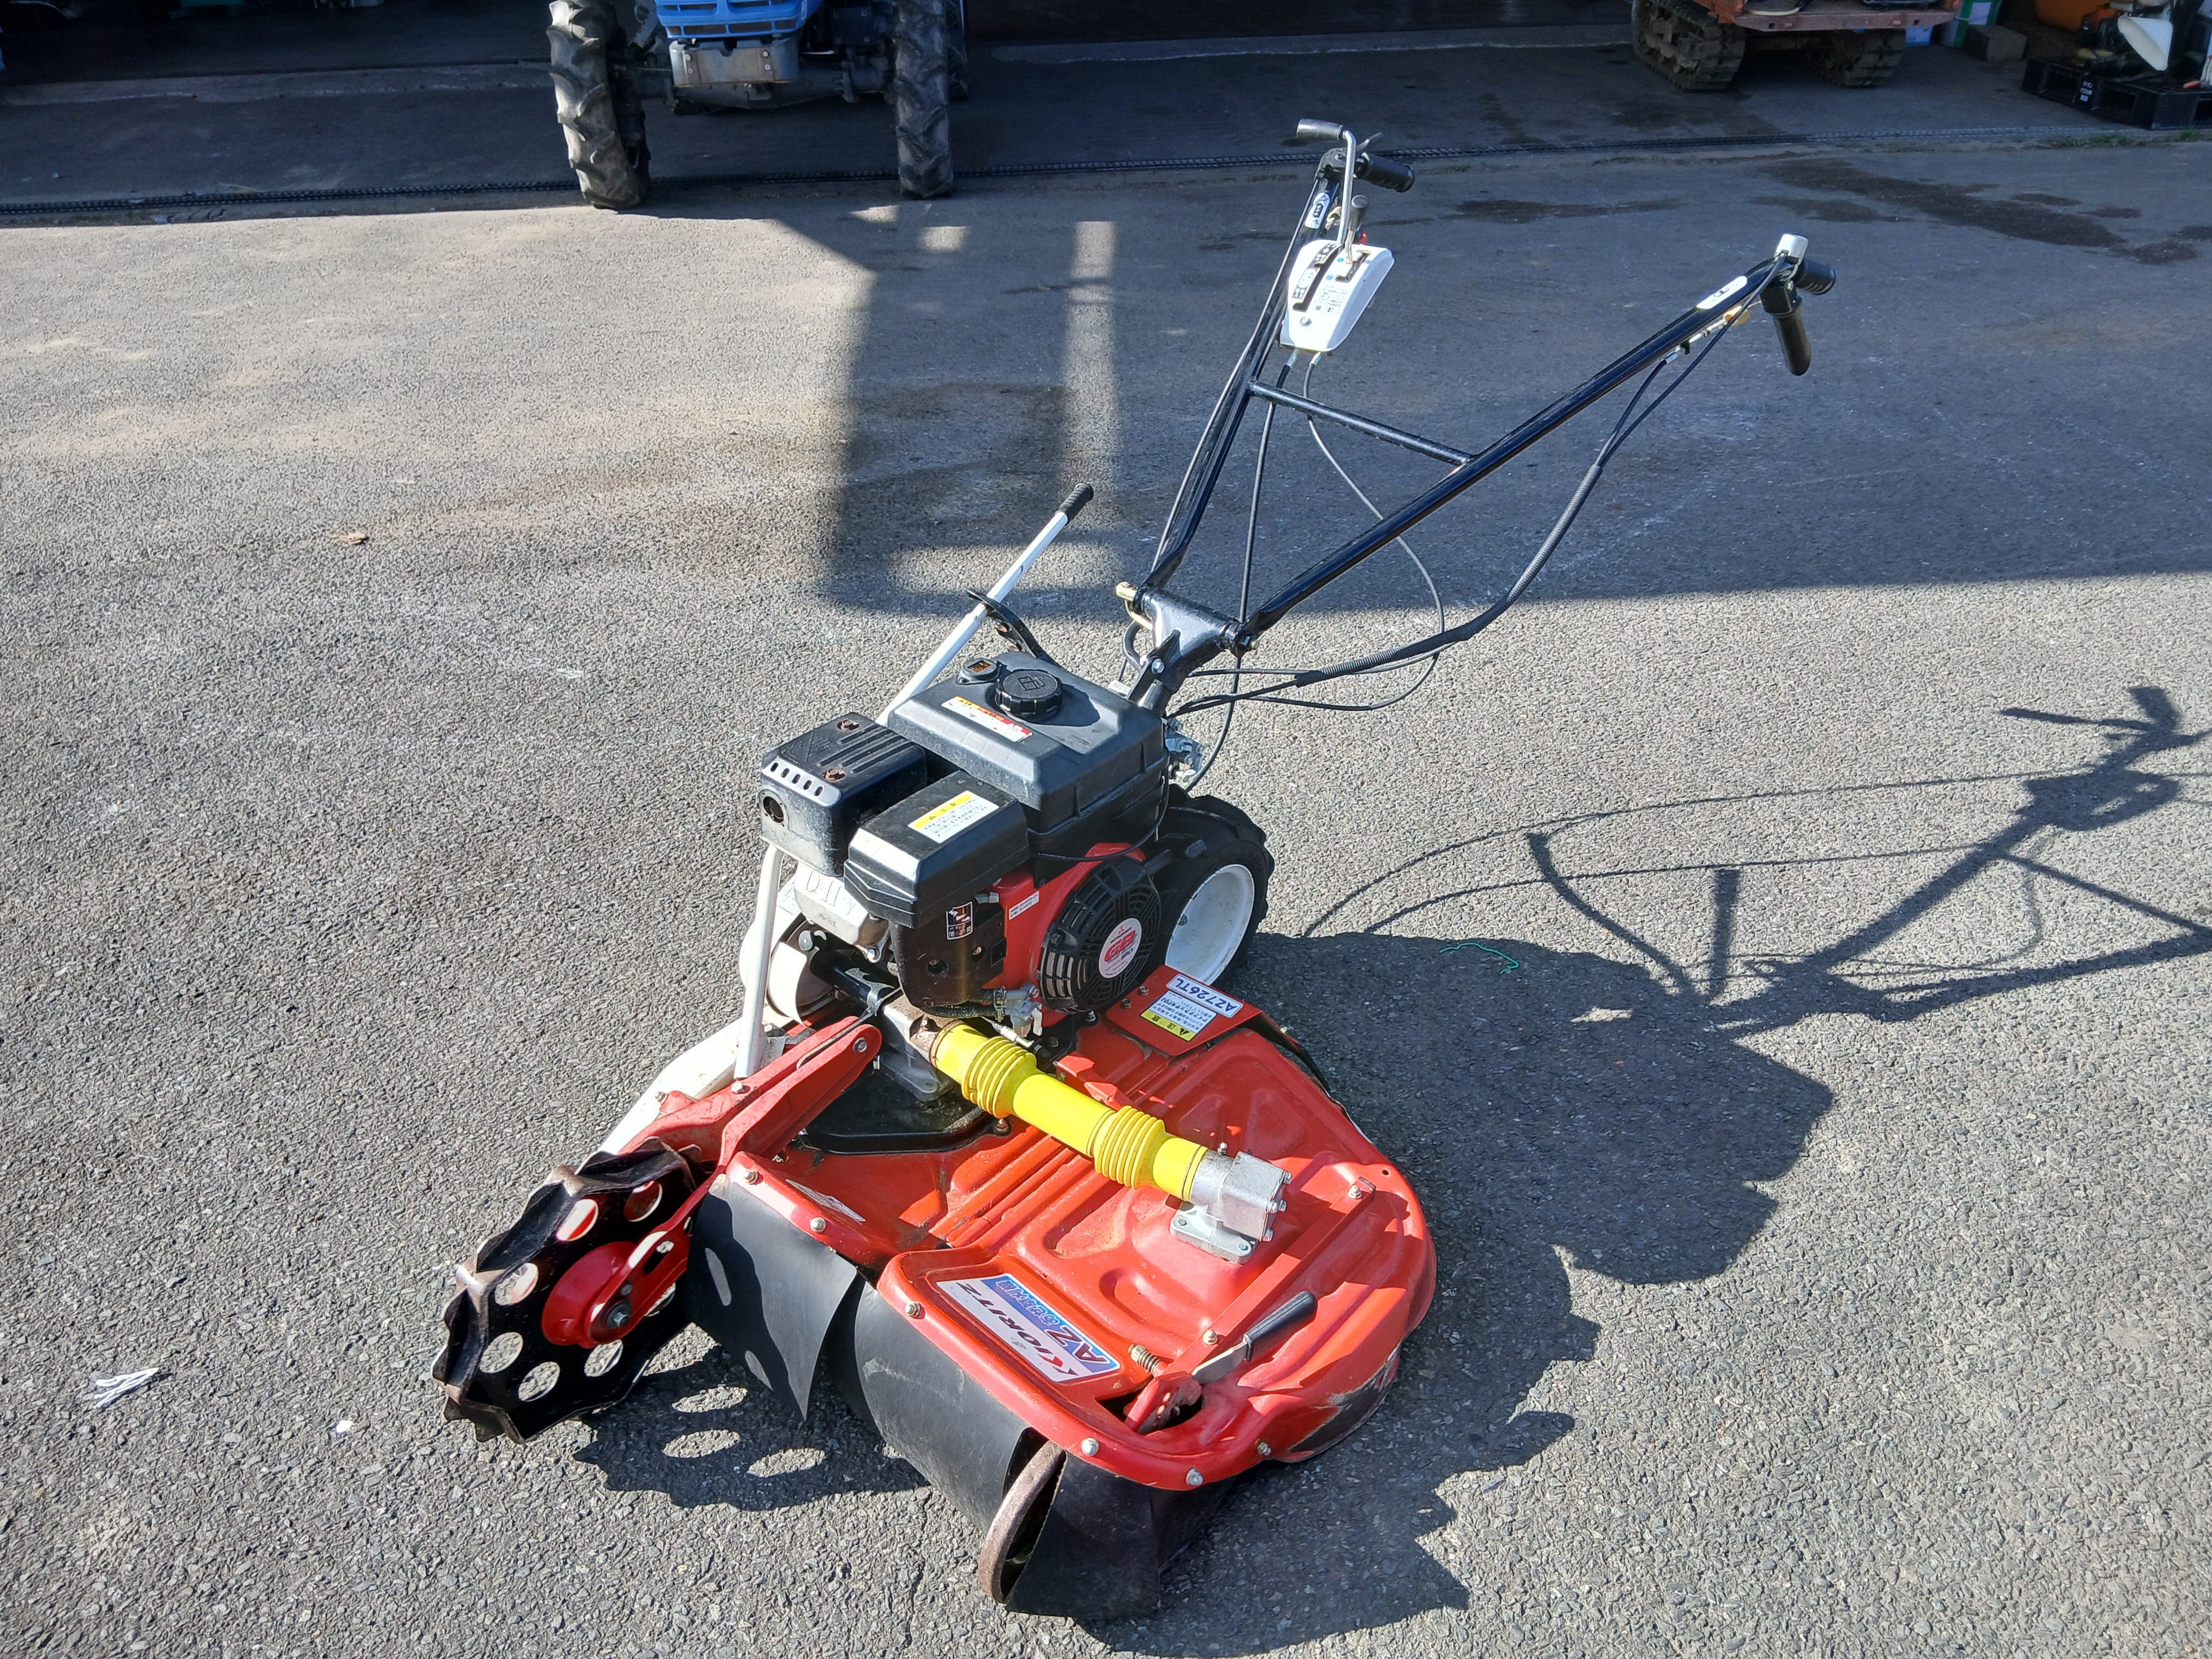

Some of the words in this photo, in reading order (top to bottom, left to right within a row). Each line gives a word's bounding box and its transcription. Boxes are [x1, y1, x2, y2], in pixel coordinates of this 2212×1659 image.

[1104, 930, 1136, 962] GB
[1174, 978, 1237, 1012] AZ726TL
[1152, 1014, 1177, 1030] 注意
[995, 1280, 1060, 1326] あぜ草刈機
[956, 1283, 1079, 1375] KIORITZ
[1046, 1326, 1111, 1365] AZ
